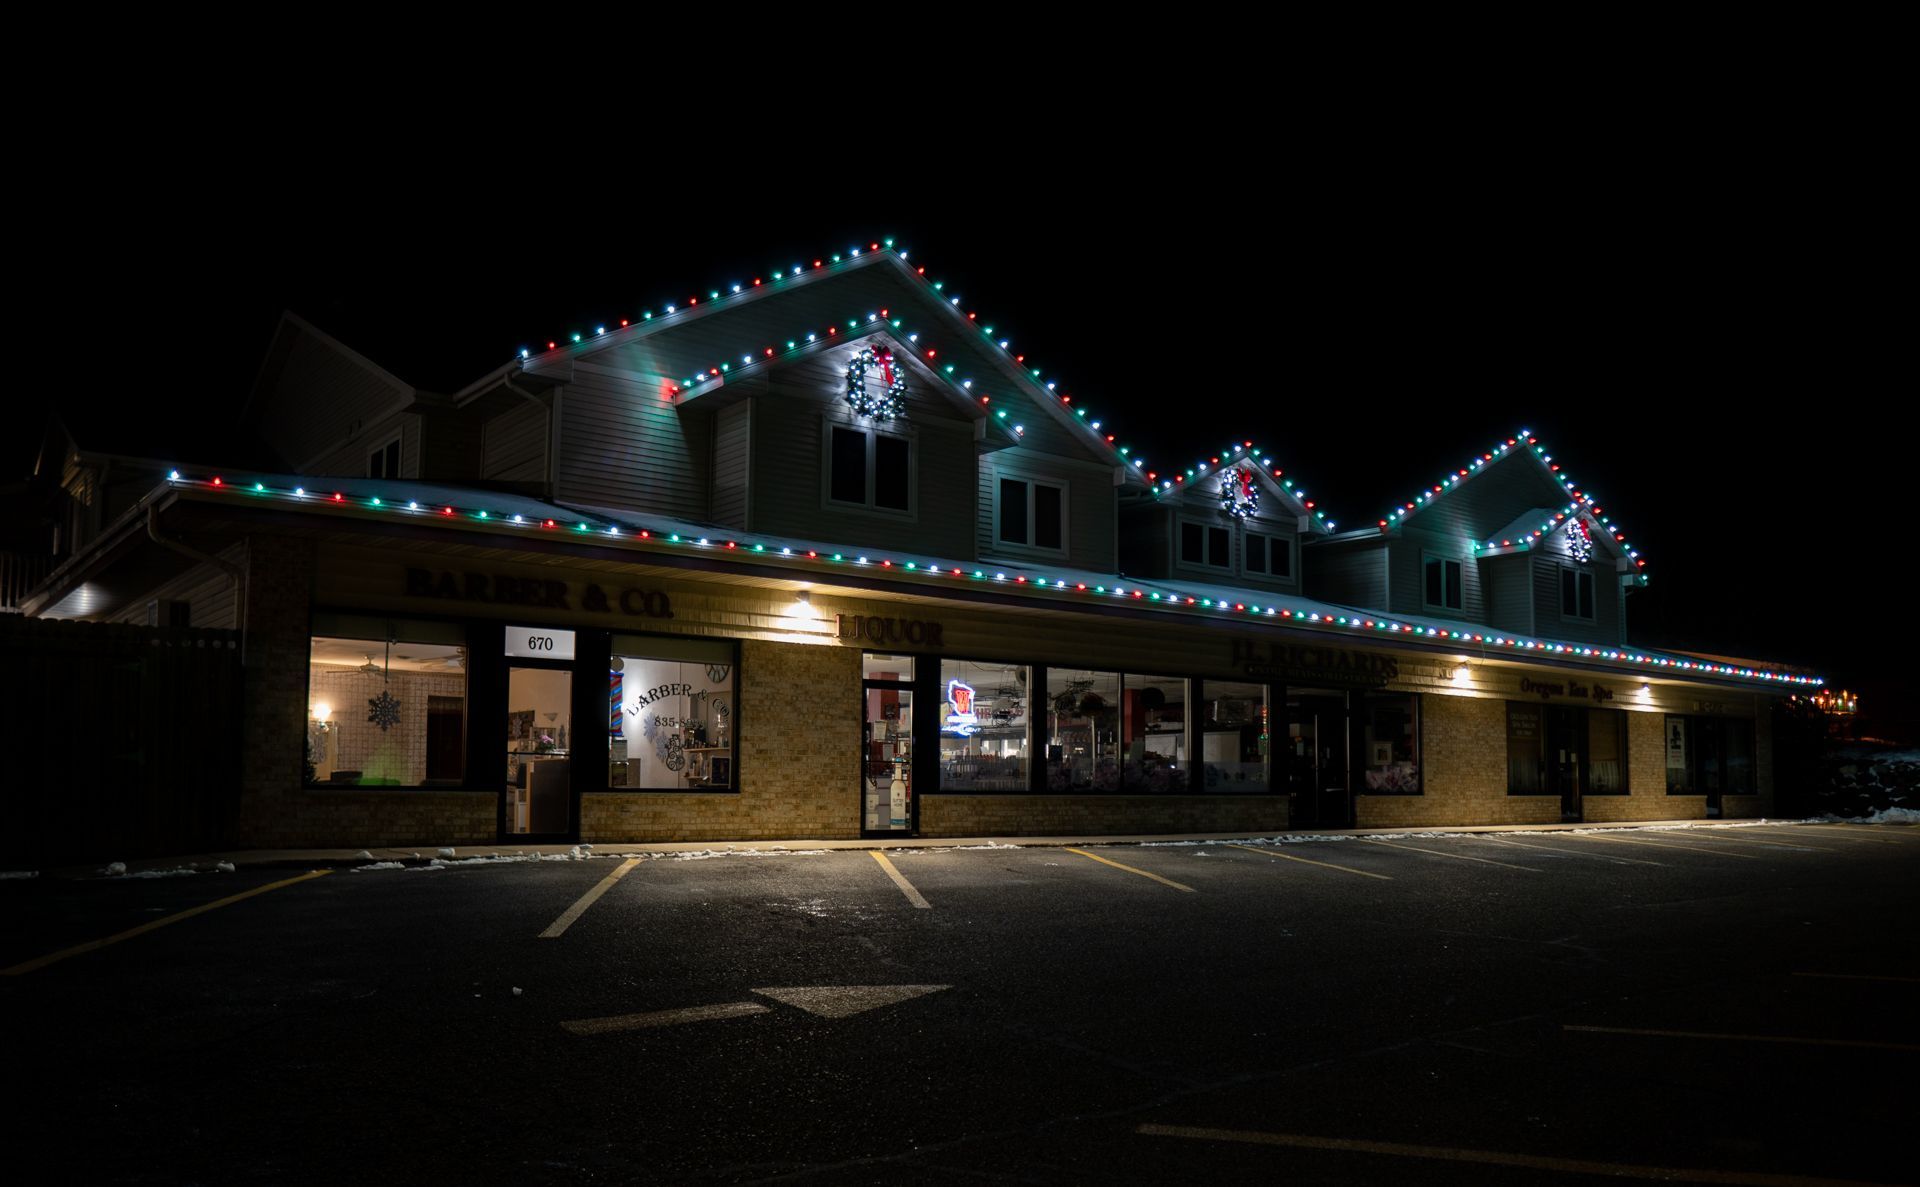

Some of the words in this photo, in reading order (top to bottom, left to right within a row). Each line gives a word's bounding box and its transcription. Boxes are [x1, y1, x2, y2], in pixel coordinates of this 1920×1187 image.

[404, 567, 571, 610] BARBER
[582, 583, 611, 613] &
[619, 586, 675, 619] CO.
[528, 637, 553, 651] 670
[835, 613, 944, 646] LIQUOR
[1269, 643, 1399, 679] RICHARDS
[1568, 680, 1588, 697] Tan
[1593, 682, 1613, 704] Spa
